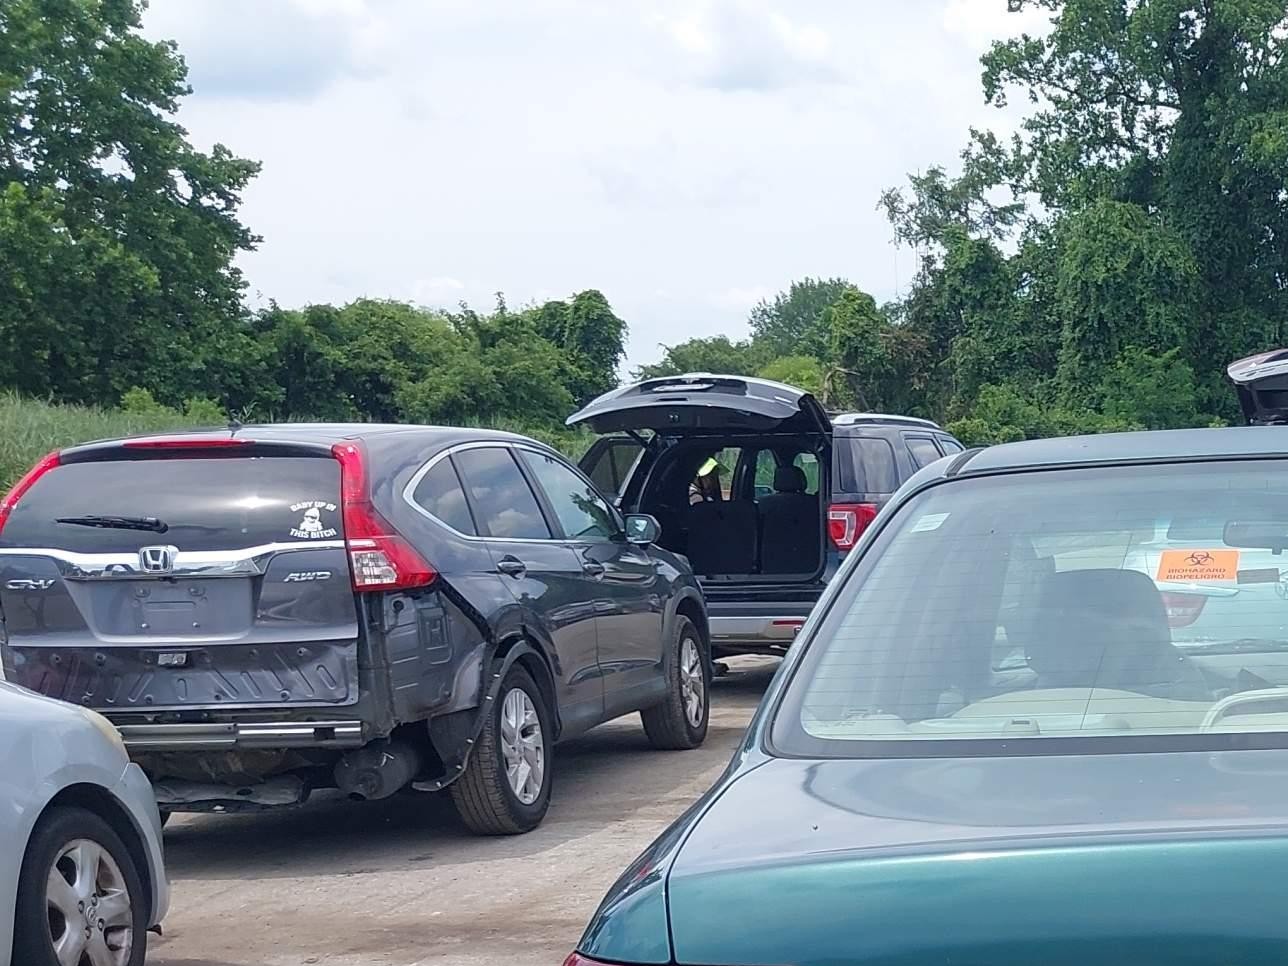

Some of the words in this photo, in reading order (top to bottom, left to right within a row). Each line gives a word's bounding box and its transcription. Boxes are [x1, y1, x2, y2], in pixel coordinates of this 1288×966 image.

[290, 528, 309, 538] THIS
[310, 528, 337, 538] BITCH
[283, 571, 331, 582] AWD
